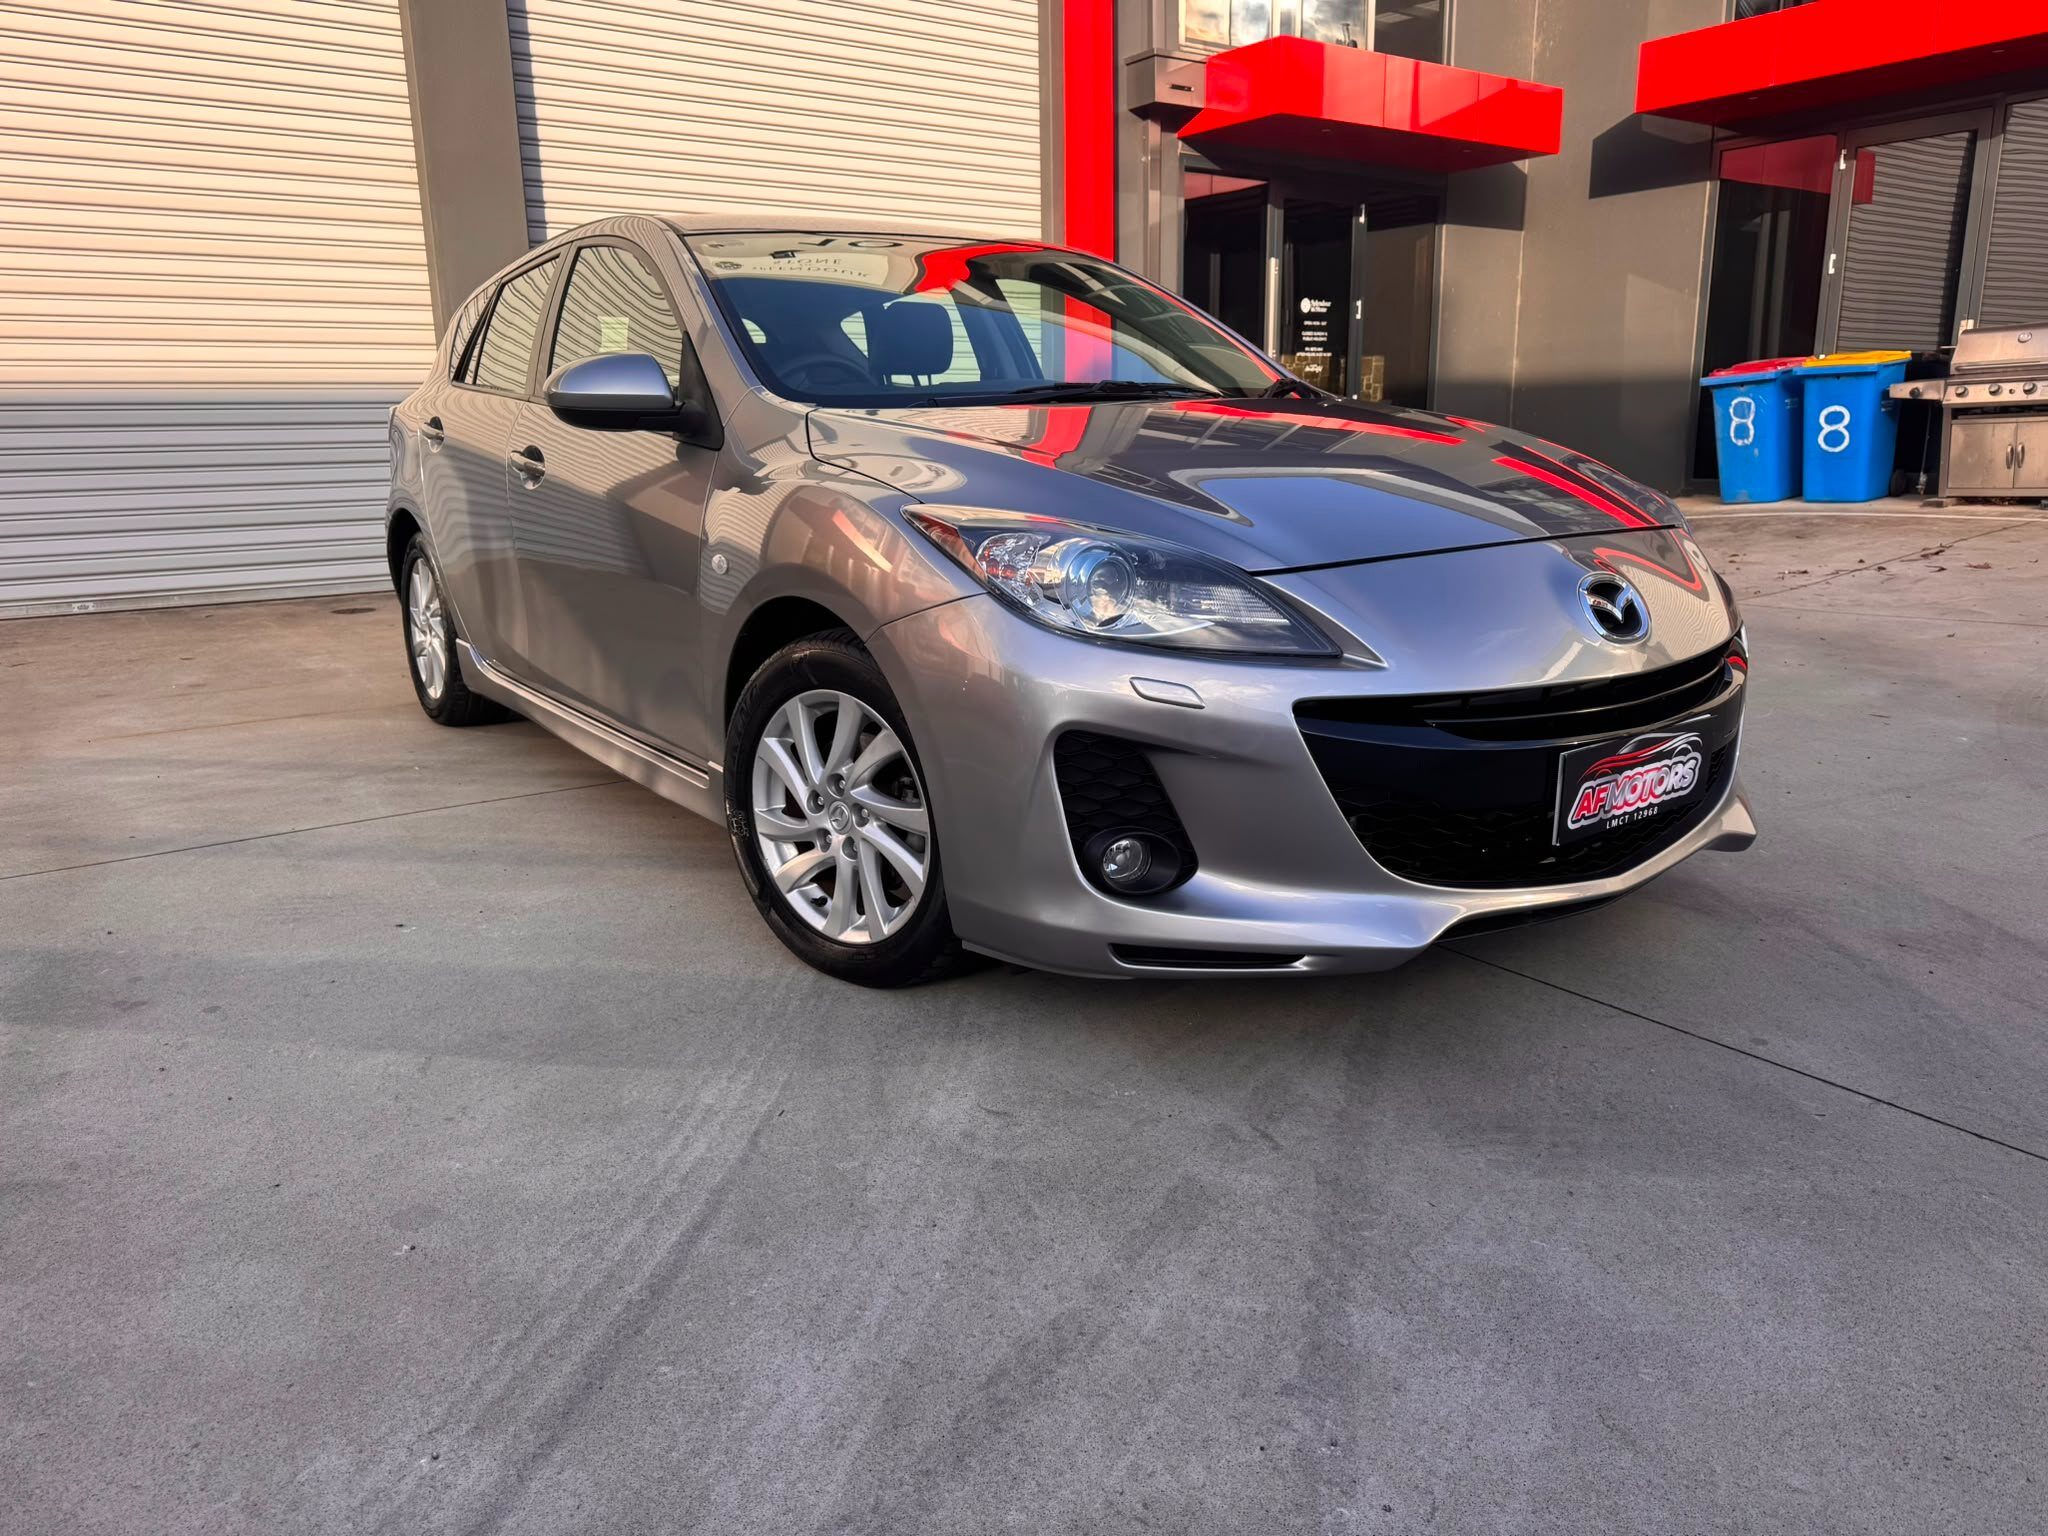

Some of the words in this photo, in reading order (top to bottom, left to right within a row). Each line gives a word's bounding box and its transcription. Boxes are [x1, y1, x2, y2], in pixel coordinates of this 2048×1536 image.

[1729, 396, 1756, 447] 8
[1817, 405, 1851, 453] 8
[1606, 814, 1630, 830] LMCT
[1633, 807, 1658, 820] 12968
